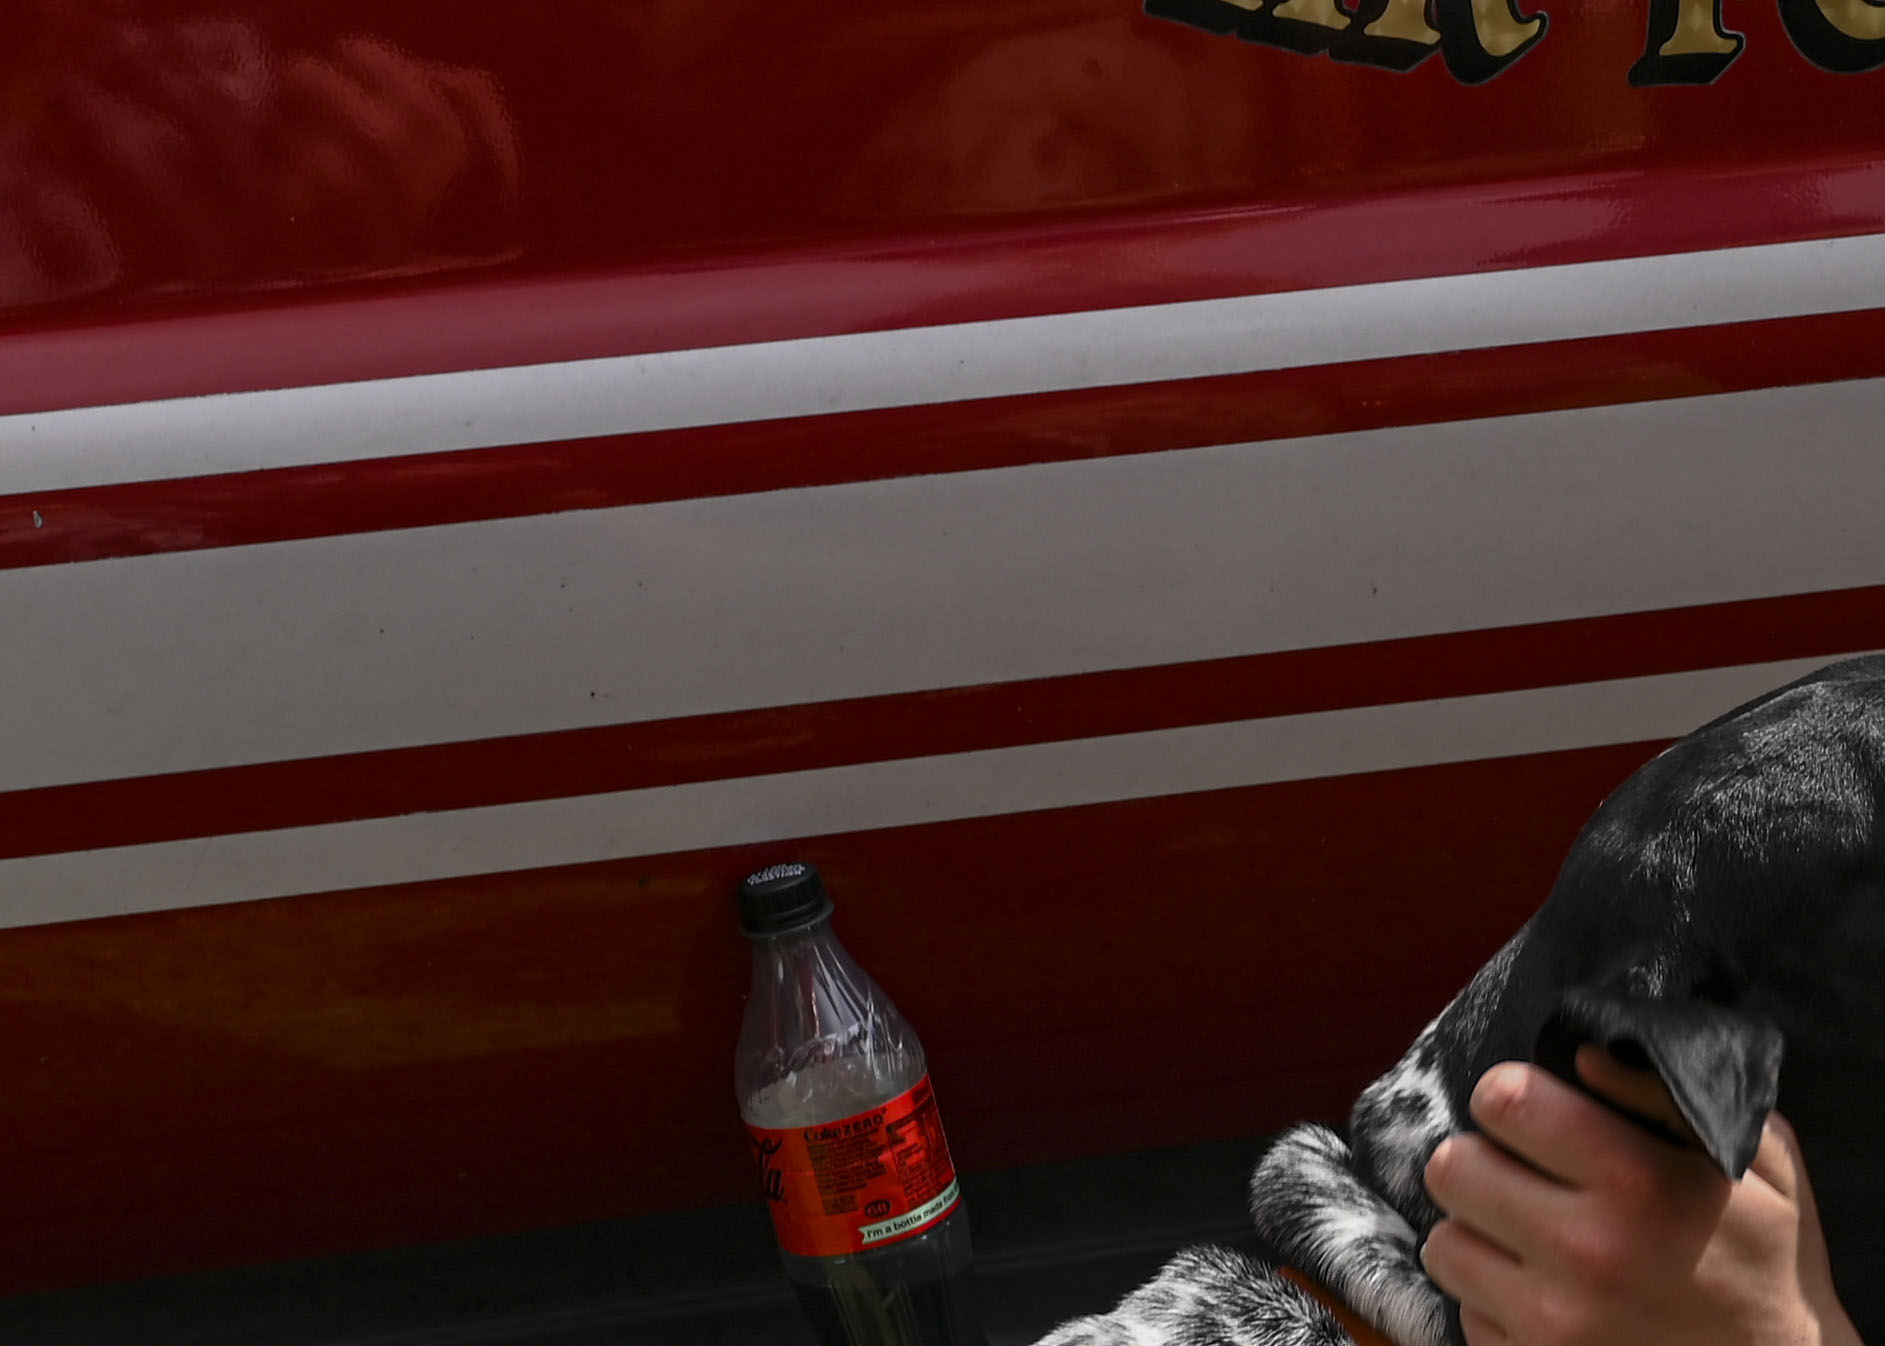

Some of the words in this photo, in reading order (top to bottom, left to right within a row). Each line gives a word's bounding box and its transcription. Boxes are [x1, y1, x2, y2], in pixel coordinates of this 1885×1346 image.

[867, 1228, 883, 1239] I'm
[885, 1225, 892, 1233] a
[894, 1214, 922, 1231] bottle
[923, 1202, 943, 1218] made
